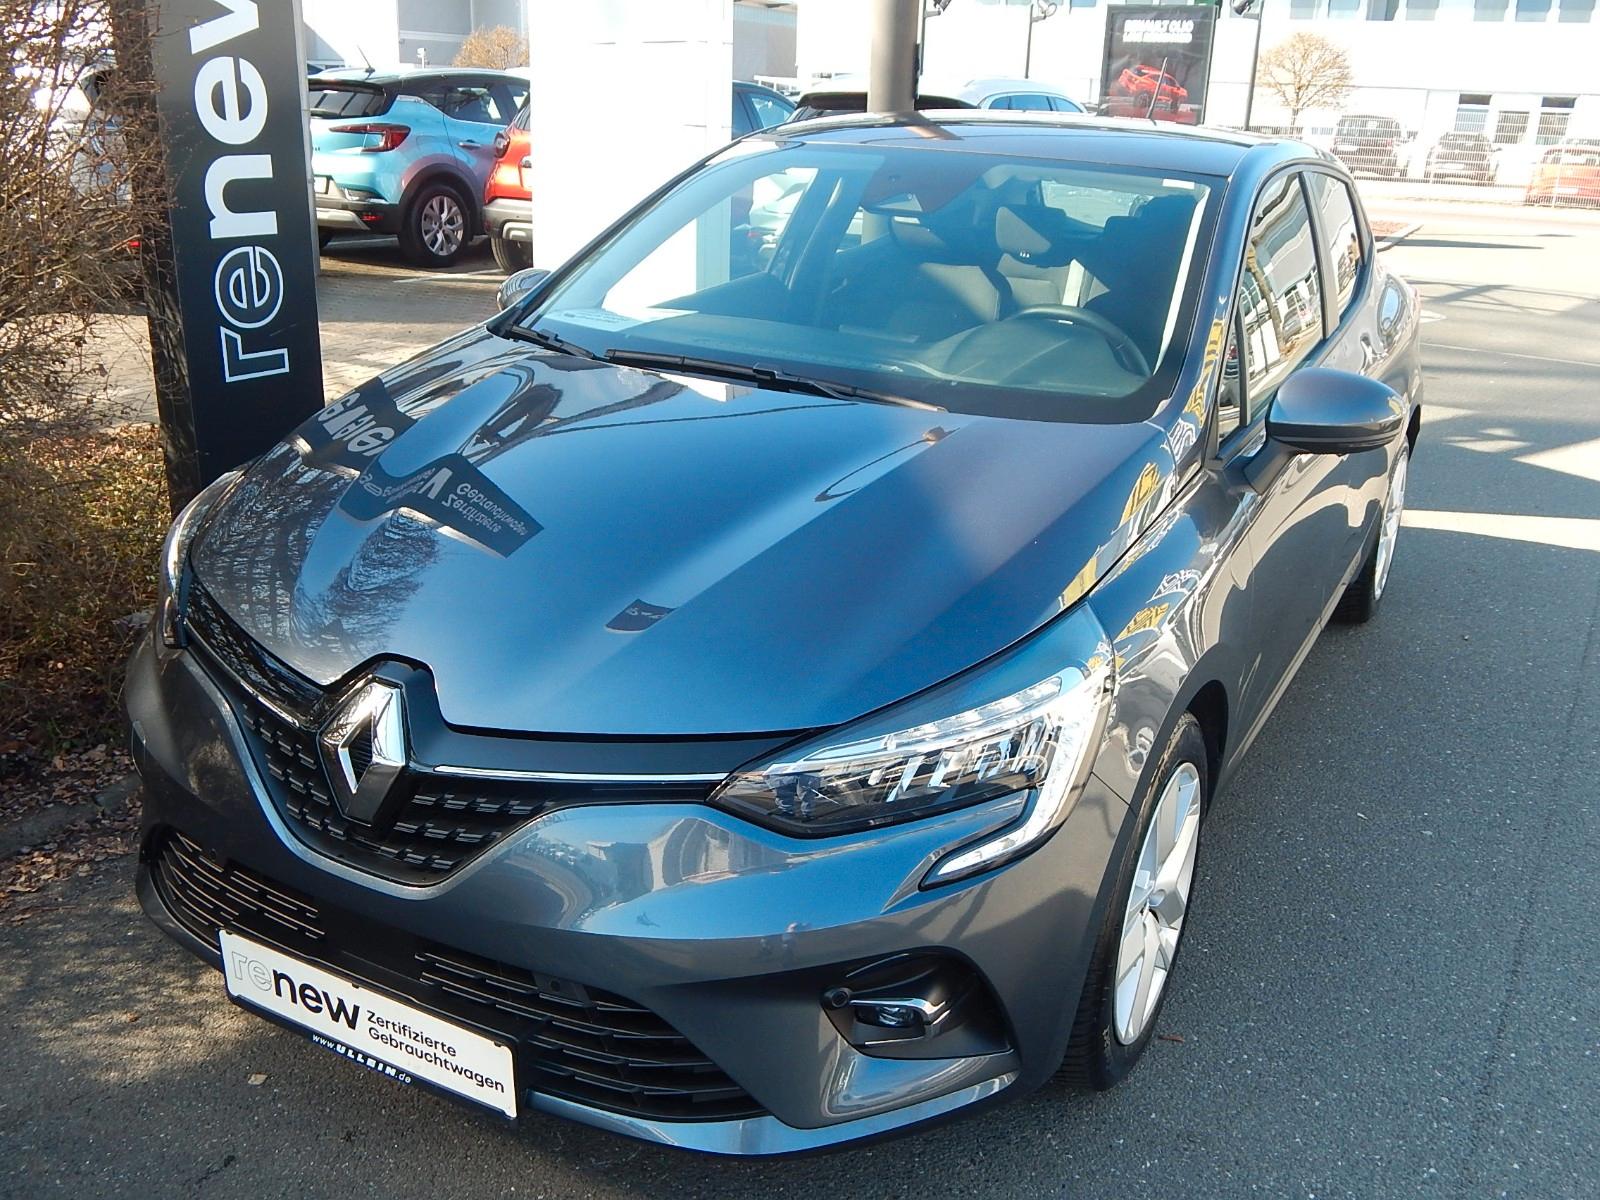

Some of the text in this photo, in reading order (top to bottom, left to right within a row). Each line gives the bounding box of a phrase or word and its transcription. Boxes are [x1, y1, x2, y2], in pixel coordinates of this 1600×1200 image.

[231, 950, 361, 1031] renew
[366, 1009, 457, 1057] Zertifizierte
[368, 1026, 505, 1093] Gebrauchtwagen
